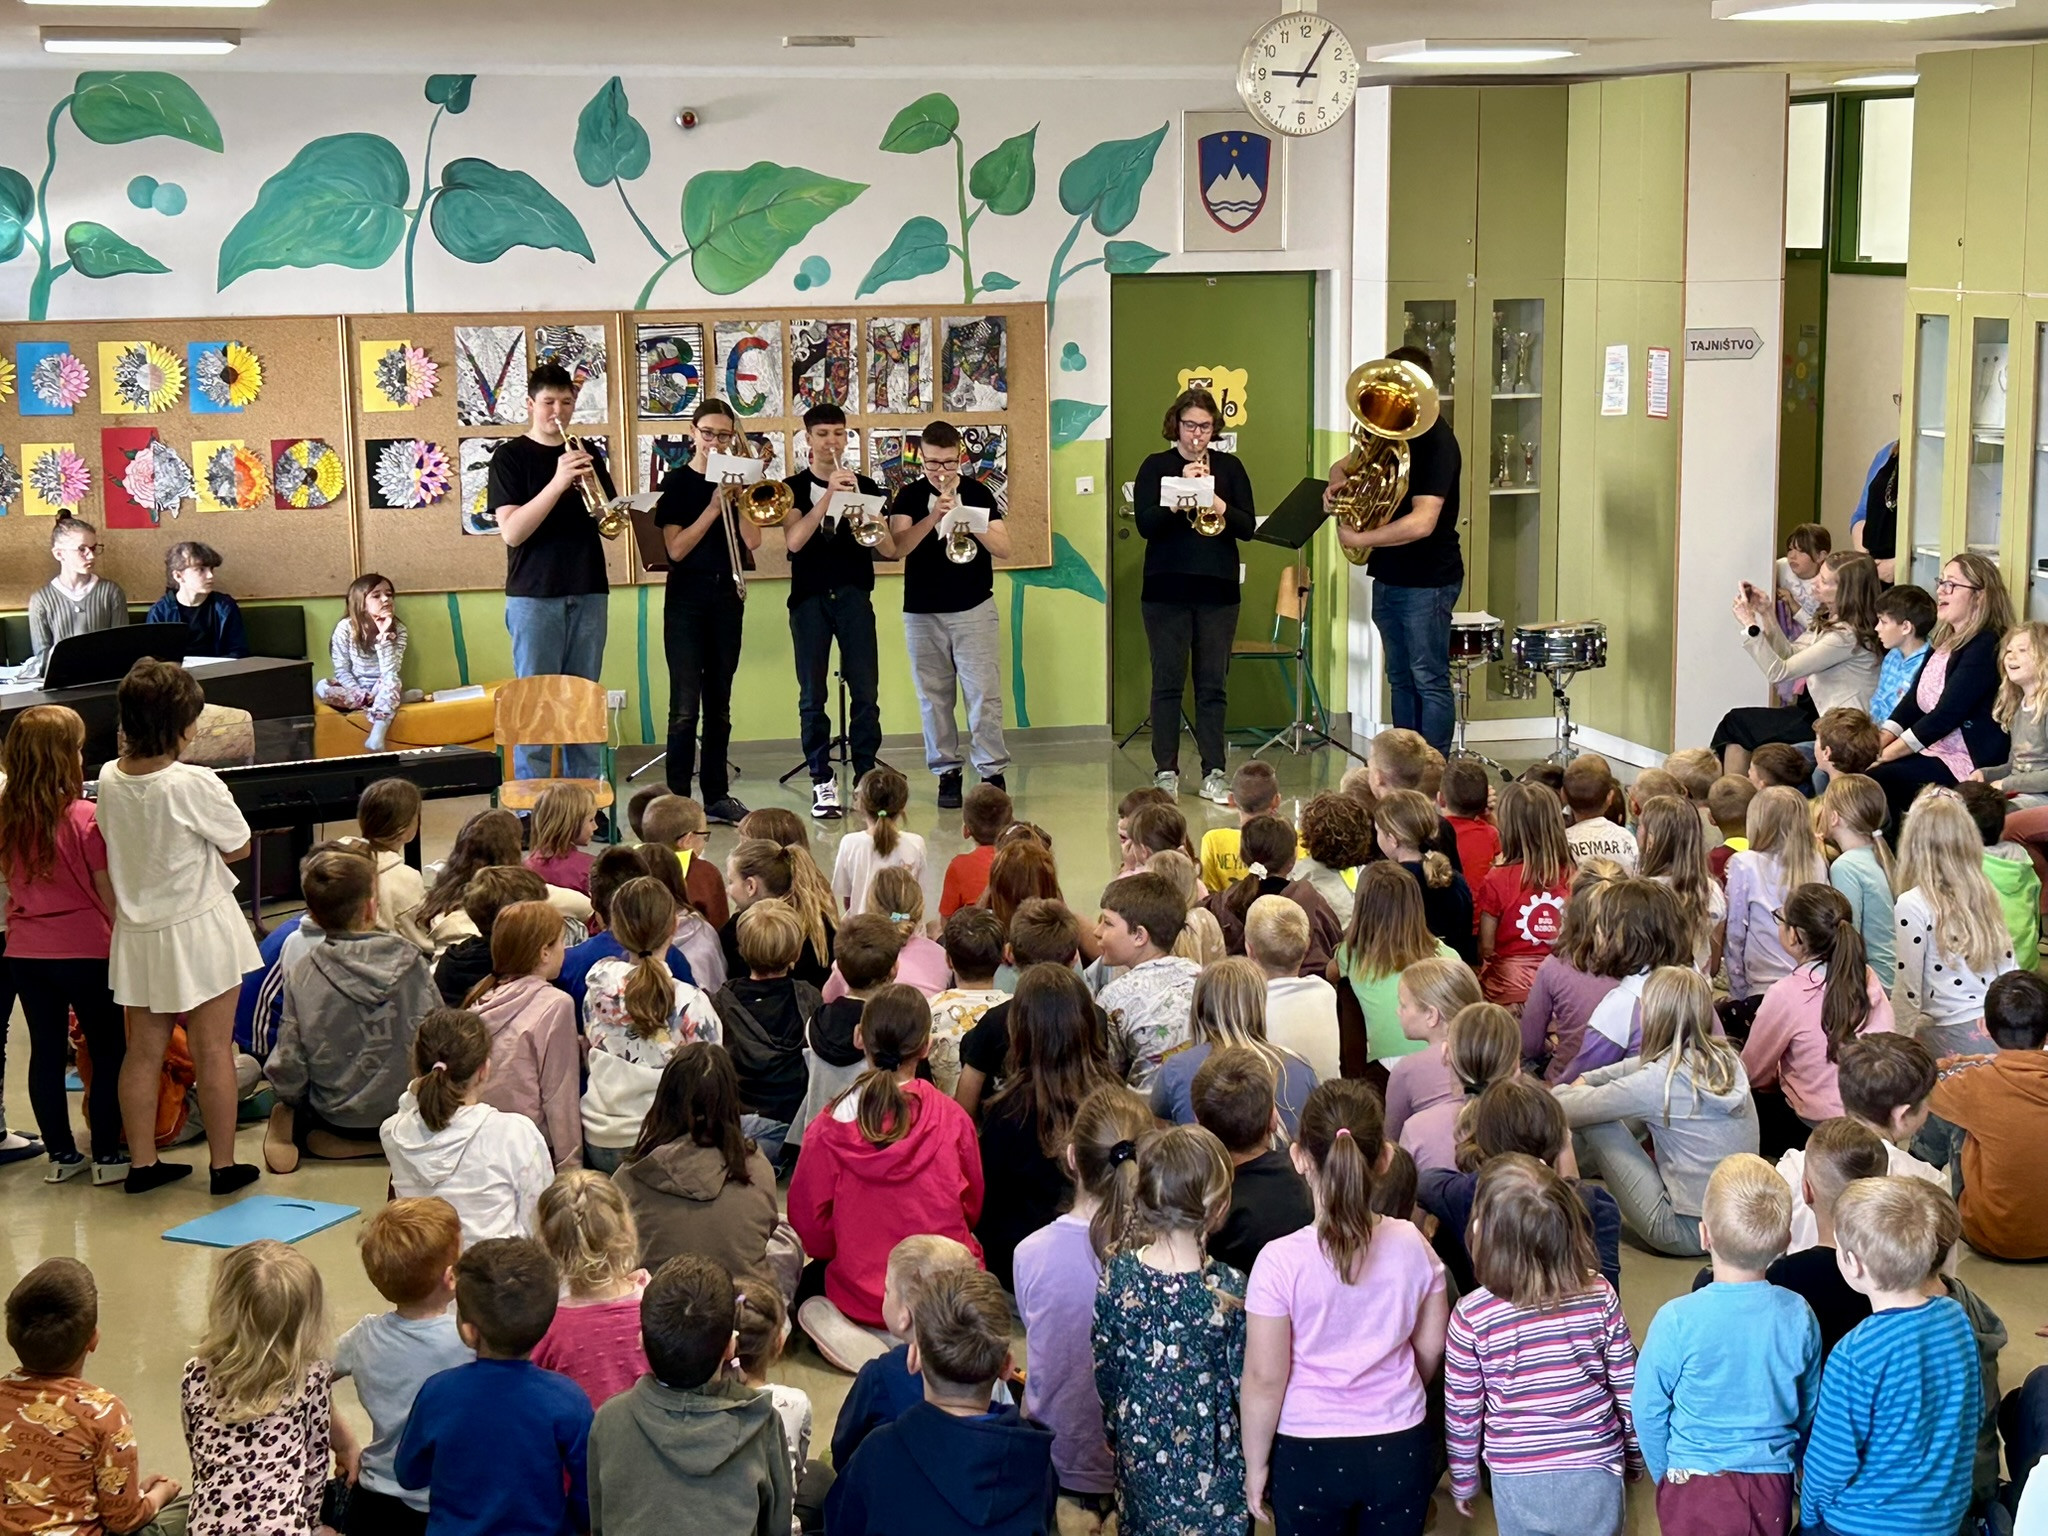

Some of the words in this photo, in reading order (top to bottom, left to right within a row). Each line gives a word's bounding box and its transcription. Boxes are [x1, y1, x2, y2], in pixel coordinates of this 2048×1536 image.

[1280, 30, 1289, 43] 11
[1300, 25, 1311, 38] 12
[1264, 44, 1276, 58] 10
[1334, 47, 1342, 61] 2
[1258, 67, 1267, 80] 9
[1339, 70, 1347, 84] 3
[1263, 91, 1272, 103] 8
[1331, 92, 1339, 104] 4
[1277, 105, 1286, 119] 7
[1297, 112, 1306, 125] 6
[1317, 106, 1326, 119] 5
[1690, 338, 1754, 351] TAJNIŠTVO
[1569, 840, 1620, 857] NEYMAR
